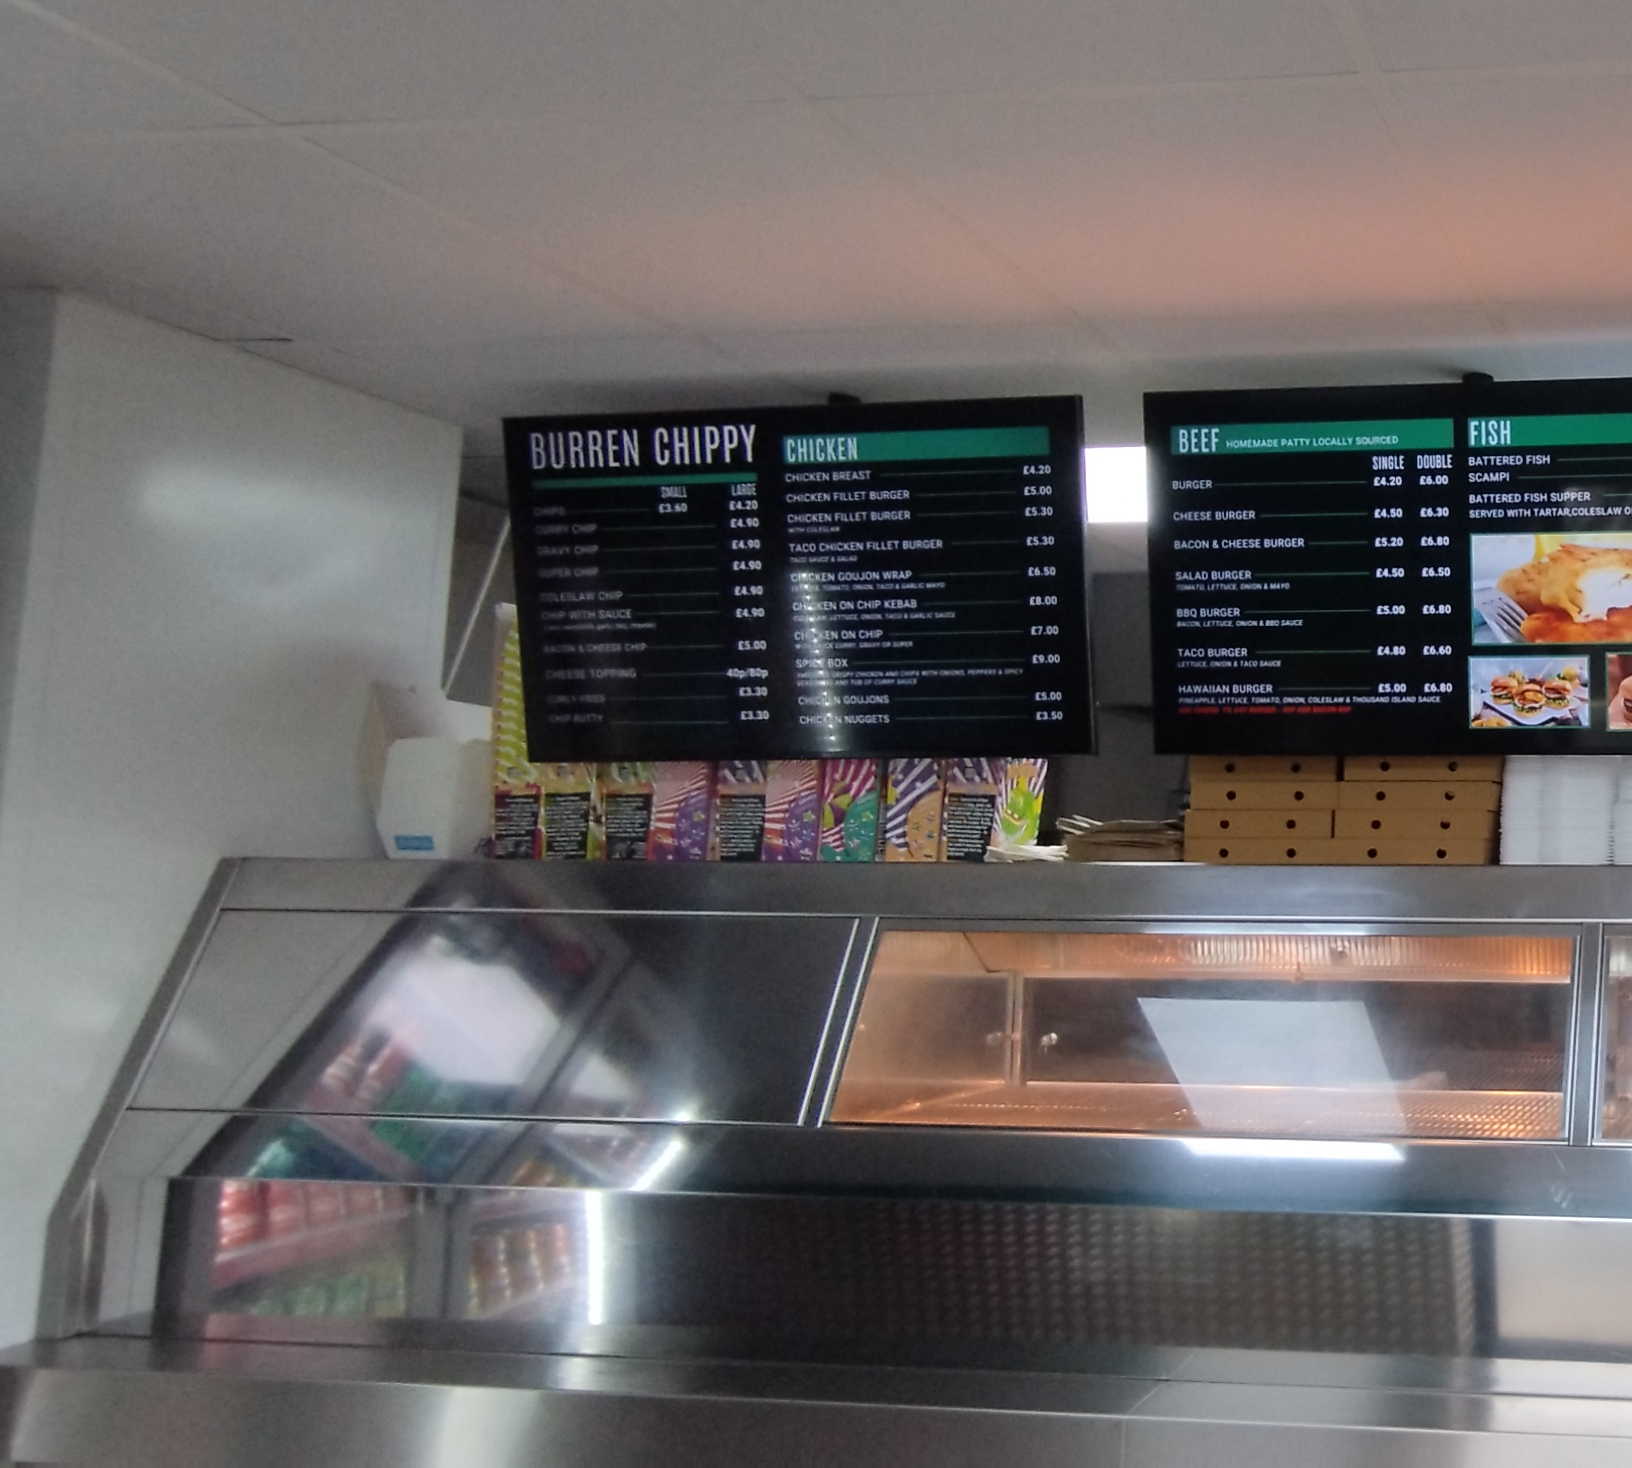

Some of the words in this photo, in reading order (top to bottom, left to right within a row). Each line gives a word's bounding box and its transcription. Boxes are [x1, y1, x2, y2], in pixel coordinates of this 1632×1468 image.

[1469, 421, 1512, 445] FISH
[529, 430, 640, 468] BURREN
[653, 426, 757, 464] CHIPPY
[1178, 429, 1220, 453] BEEF
[1225, 439, 1279, 448] HOMEMADE
[1280, 438, 1311, 447] PATTY
[1312, 437, 1353, 447] LOCALLY
[1355, 436, 1399, 446] SOURCED
[786, 437, 859, 462] CHICKEN
[1372, 455, 1405, 470] SINGLE
[1416, 454, 1453, 469] DOUBLE
[1468, 454, 1524, 466] BATTERED
[1525, 454, 1551, 465] FISH
[785, 472, 830, 483] CHICKEN
[832, 470, 872, 481] BREAST
[1022, 465, 1052, 476] £4.20
[1468, 471, 1510, 483] SCAMPI
[1171, 479, 1213, 490] BURGER
[1373, 475, 1403, 487] £4.20
[1419, 474, 1449, 486] £6.00
[786, 492, 831, 503] CHICKEN
[832, 491, 867, 502] FILLET
[869, 489, 910, 501] BURGER
[1023, 485, 1053, 497] £5.00
[1468, 493, 1522, 504] BATTERED
[1523, 492, 1548, 503] FISH
[1550, 491, 1591, 502] SUPPER
[1172, 511, 1212, 521] CHEESE
[1214, 510, 1256, 521] BURGER
[1373, 507, 1403, 518] £4.50
[1419, 506, 1450, 517] £6.30
[1468, 508, 1505, 519] SERVED
[1506, 508, 1532, 518] WITH
[788, 543, 817, 553] TACO
[818, 541, 864, 552] CHICKEN
[865, 540, 900, 551] FILLET
[902, 539, 944, 550] BURGER
[1026, 536, 1055, 547] £5.30
[1173, 539, 1210, 550] BACON
[1212, 539, 1219, 549] &
[1221, 538, 1261, 549] CHEESE
[1263, 537, 1305, 548] BURGER
[1374, 535, 1404, 547] £5.20
[1420, 535, 1450, 546] £6.80
[1175, 571, 1209, 581] SALAD
[1210, 570, 1252, 580] BURGER
[1375, 567, 1405, 578] £4.50
[1421, 566, 1451, 577] £6.50
[1176, 608, 1198, 618] BBQ
[1199, 607, 1241, 618] BURGER
[1376, 604, 1406, 615] £5.00
[1422, 603, 1452, 614] £6.80
[1232, 683, 1273, 694] BURGER
[1377, 682, 1407, 693] £5.00
[1423, 682, 1453, 693] £6.80
